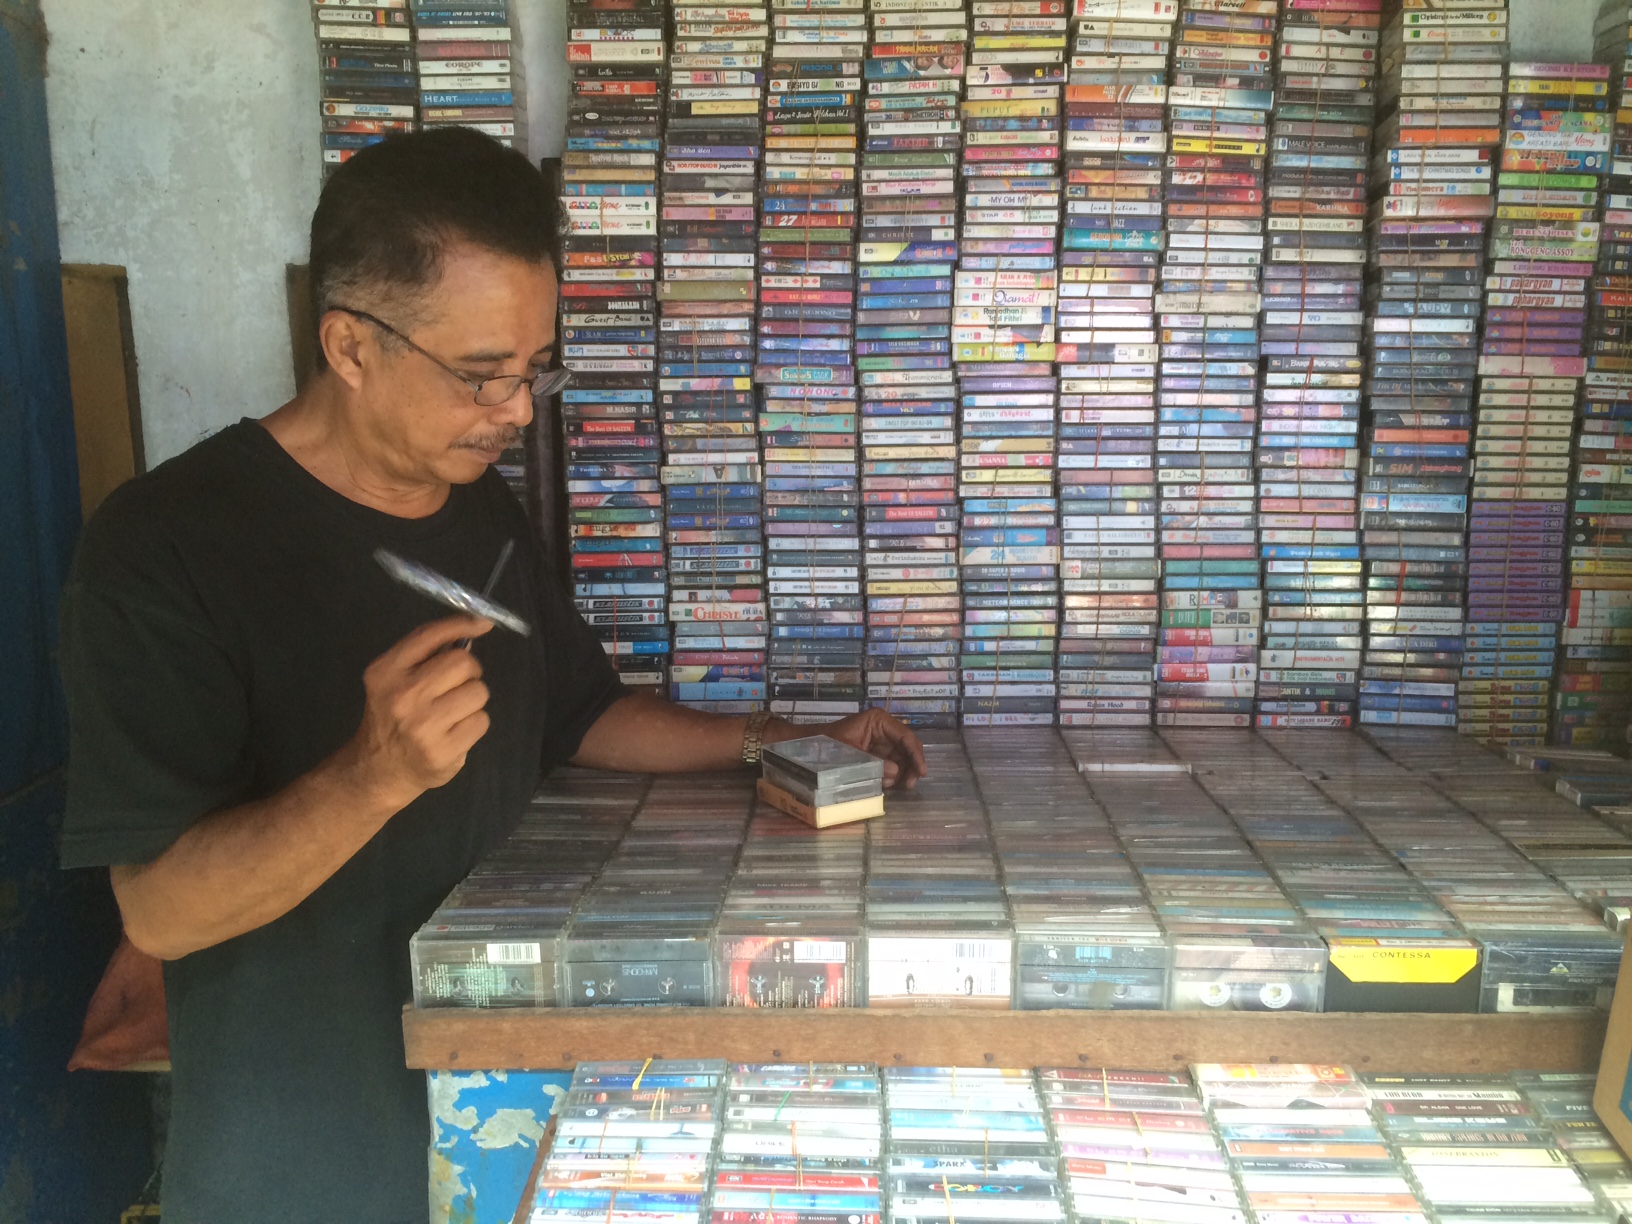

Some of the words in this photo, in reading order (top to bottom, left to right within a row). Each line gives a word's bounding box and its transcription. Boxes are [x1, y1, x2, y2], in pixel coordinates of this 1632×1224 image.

[445, 61, 484, 69] EUROPE
[693, 73, 703, 81] 22
[424, 95, 458, 103] HEART
[980, 107, 1012, 115] PUPUT
[1003, 196, 1016, 204] OH
[774, 200, 787, 210] 24
[1315, 204, 1348, 212] KARMILA
[778, 215, 799, 226] 27
[1279, 220, 1297, 228] SHEILA
[1551, 247, 1575, 256] ASSOY
[993, 289, 1041, 304] Qiamat!
[584, 315, 611, 323] Guest
[884, 390, 898, 398] 20
[606, 406, 637, 414] M.NASIR
[1389, 464, 1413, 473] SIM
[693, 606, 740, 620] CHRISYE
[1372, 951, 1432, 959] CONTESSA
